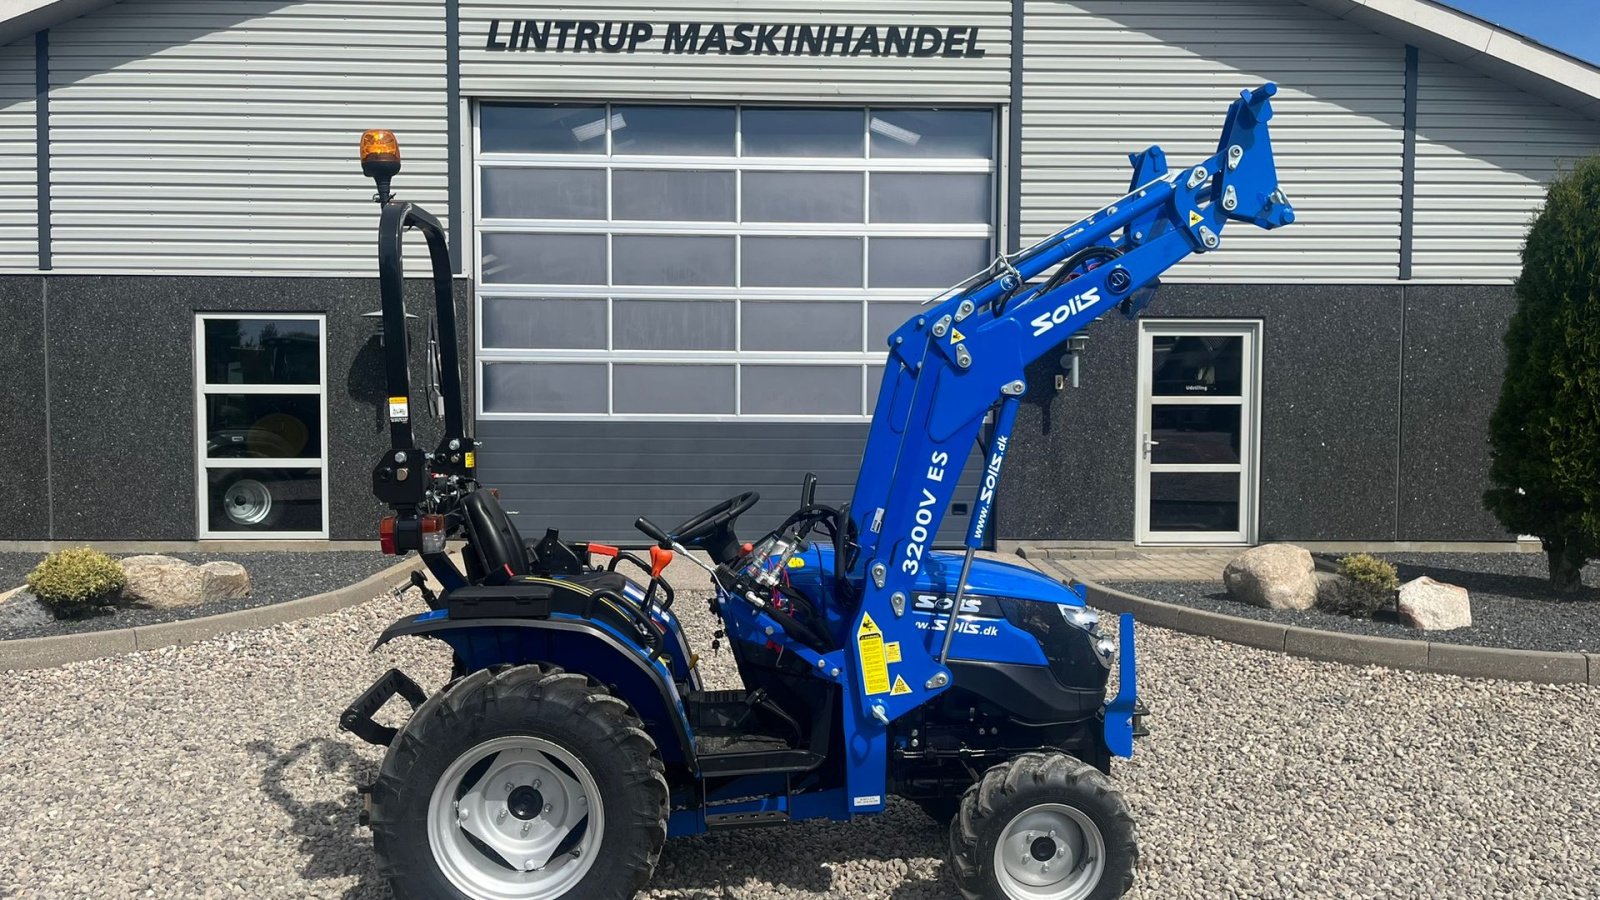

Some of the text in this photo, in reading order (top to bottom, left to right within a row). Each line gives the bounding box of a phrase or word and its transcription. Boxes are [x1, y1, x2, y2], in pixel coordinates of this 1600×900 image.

[485, 19, 986, 58] LINTRUP MASKINHANDEL
[901, 450, 949, 576] 3200V ES
